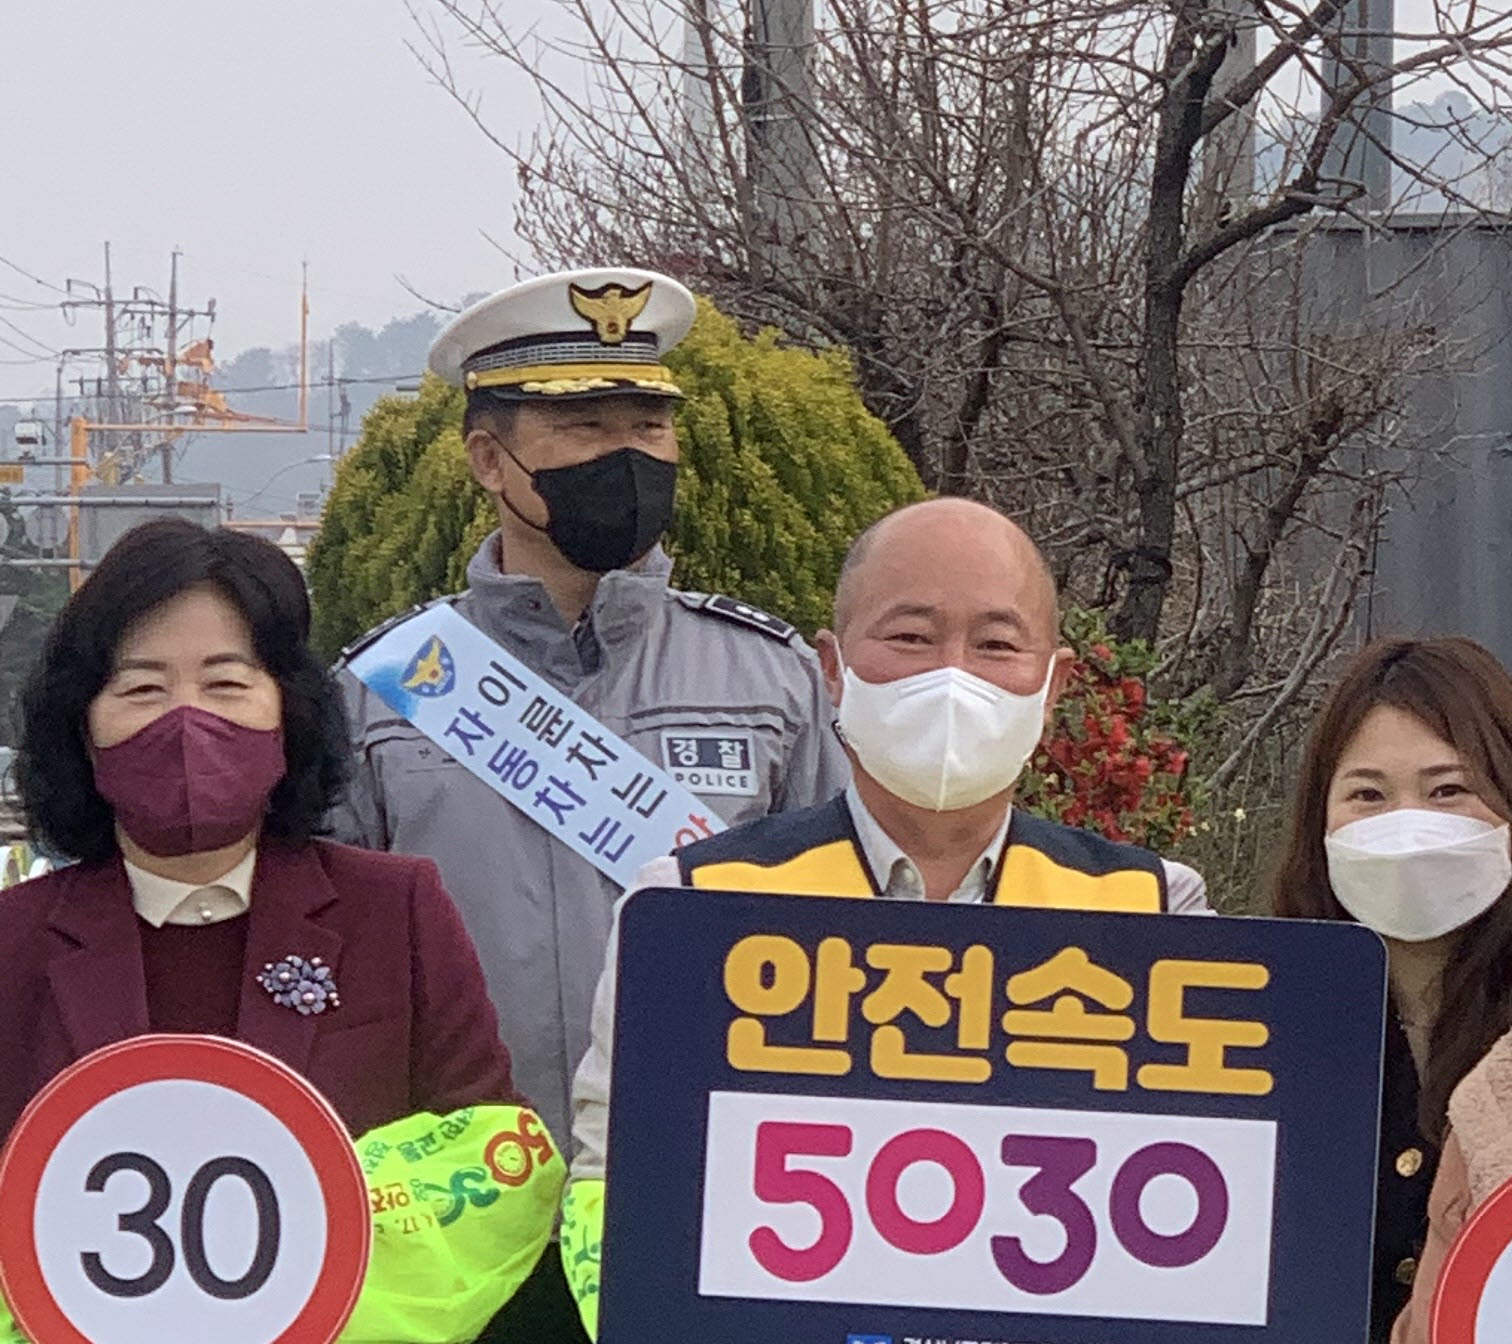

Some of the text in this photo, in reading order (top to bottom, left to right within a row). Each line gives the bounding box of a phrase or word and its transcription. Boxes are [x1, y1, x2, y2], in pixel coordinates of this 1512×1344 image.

[443, 706, 635, 864] 자동차는
[477, 660, 668, 819] 이륜차는
[674, 772, 748, 788] POLICE
[722, 933, 1276, 1097] 안전속도
[79, 1151, 281, 1301] 30
[747, 1120, 1230, 1296] 5030
